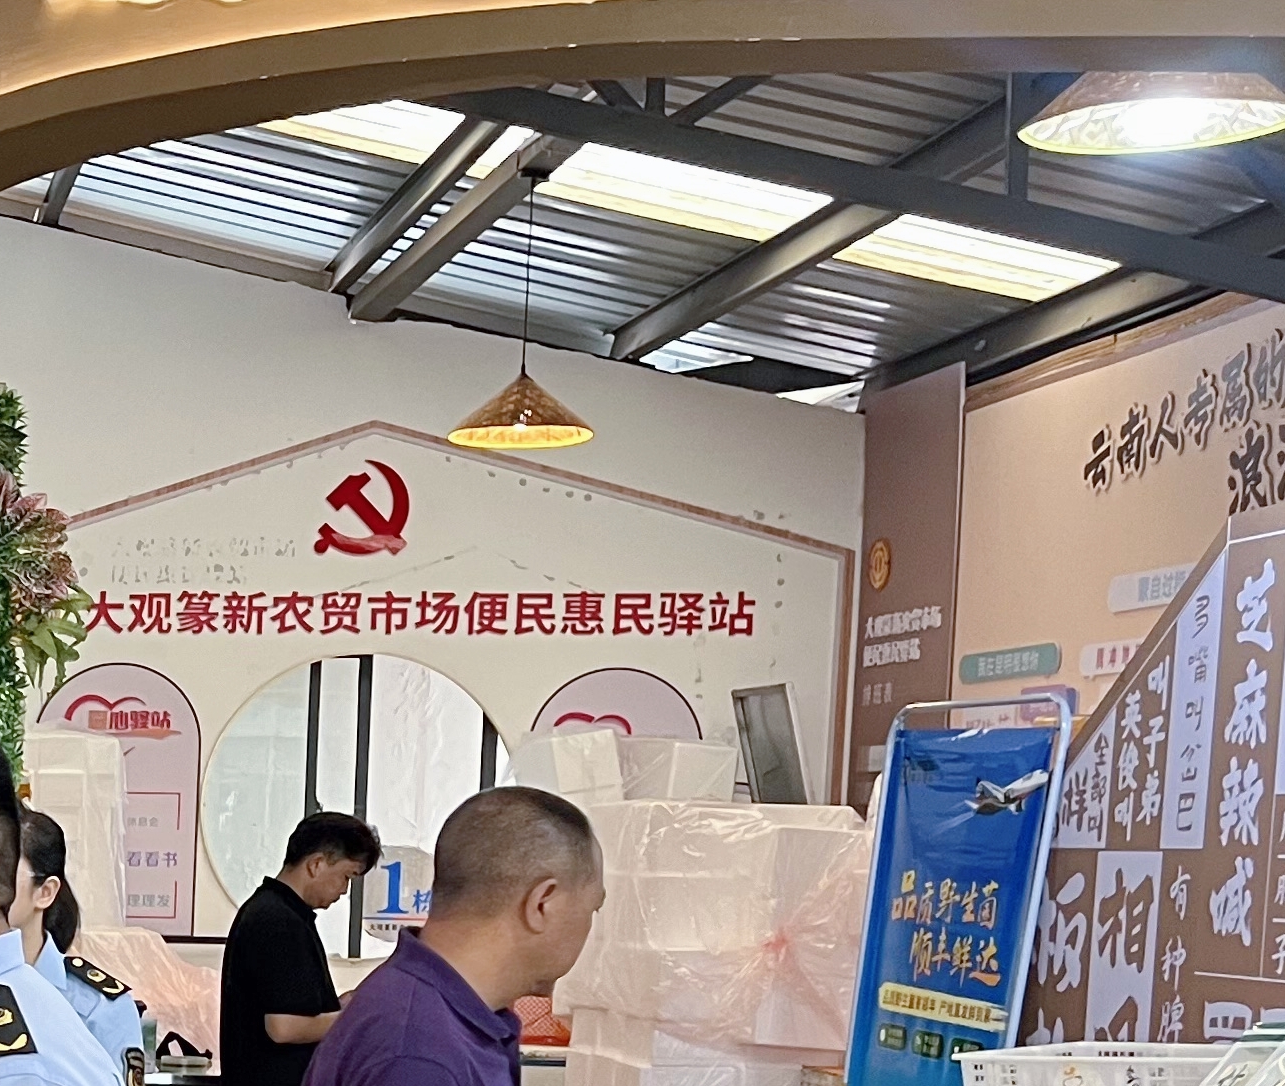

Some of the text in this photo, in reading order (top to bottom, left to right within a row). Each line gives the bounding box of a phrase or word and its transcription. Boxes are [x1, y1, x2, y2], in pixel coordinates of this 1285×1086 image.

[86, 590, 756, 637] 大观篆新农贸市场便民惠民驿站
[376, 861, 410, 914] 1
[891, 869, 1000, 930] 品质野生菌
